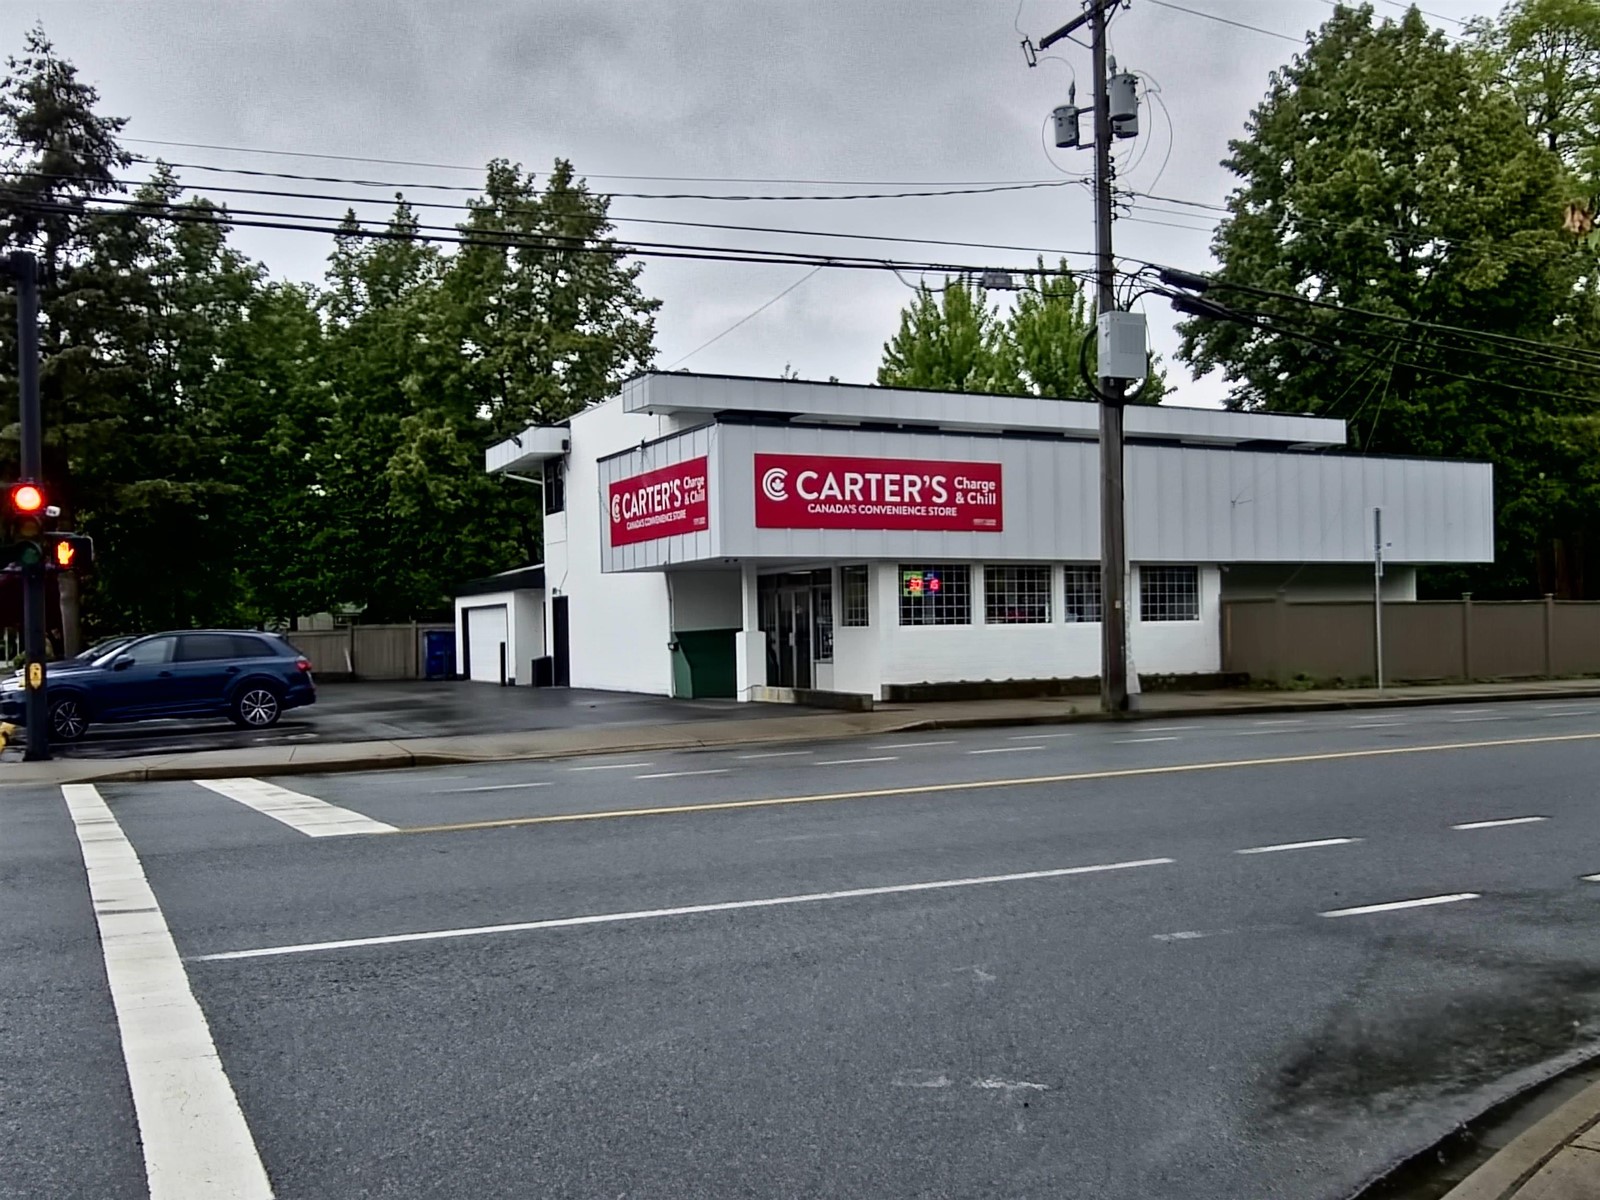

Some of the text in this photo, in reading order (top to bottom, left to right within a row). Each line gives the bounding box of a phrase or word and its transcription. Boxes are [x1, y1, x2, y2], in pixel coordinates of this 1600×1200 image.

[683, 476, 705, 490] Charge
[796, 471, 948, 504] CARTER'S
[954, 476, 996, 492] Charge
[622, 479, 681, 519] CARTER'S
[955, 492, 996, 505] & Chill
[807, 503, 957, 517] CANADA'S CONVENIENCE STORE
